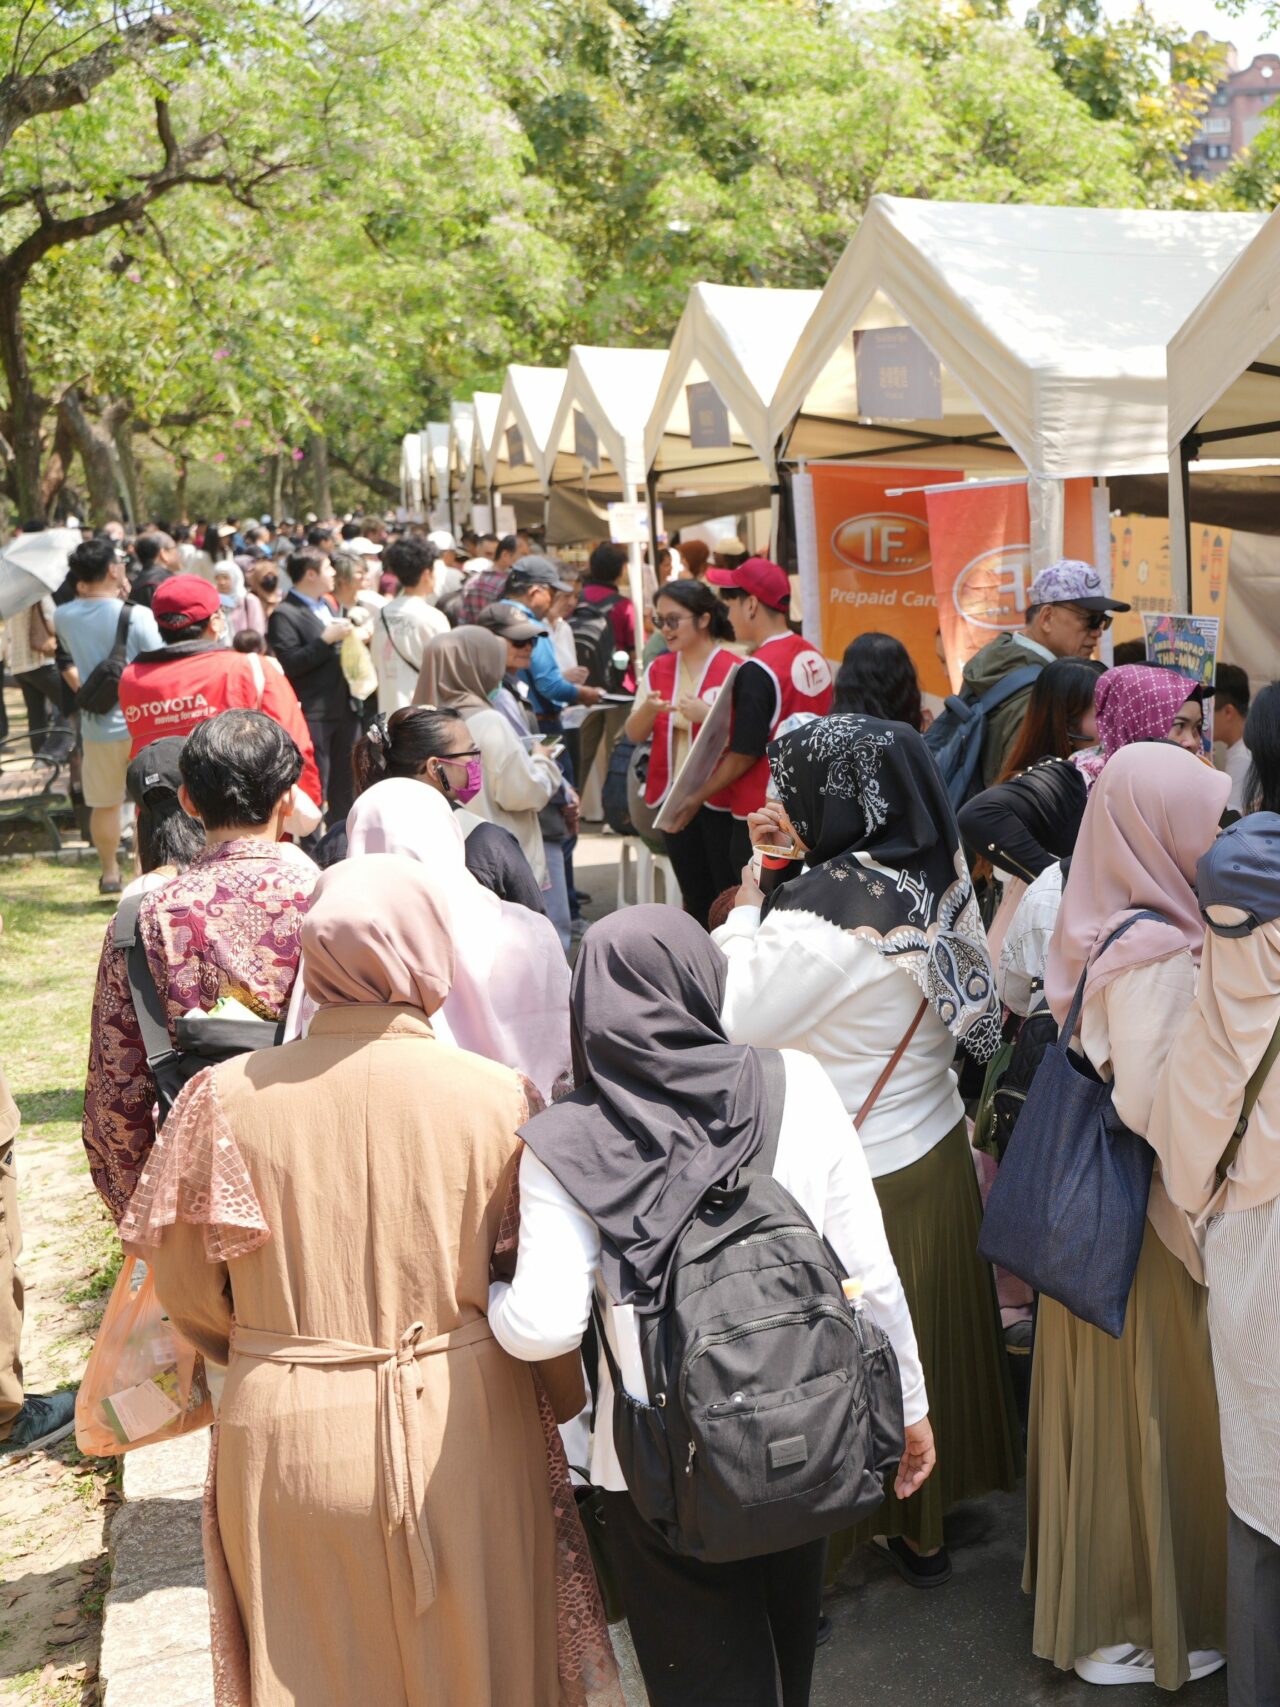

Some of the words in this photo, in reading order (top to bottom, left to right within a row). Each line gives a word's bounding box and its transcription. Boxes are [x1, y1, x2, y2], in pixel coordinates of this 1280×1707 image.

[829, 587, 897, 608] Prepaid
[141, 693, 208, 717] TOYOTA
[154, 713, 179, 726] moving
[180, 707, 209, 722] forward
